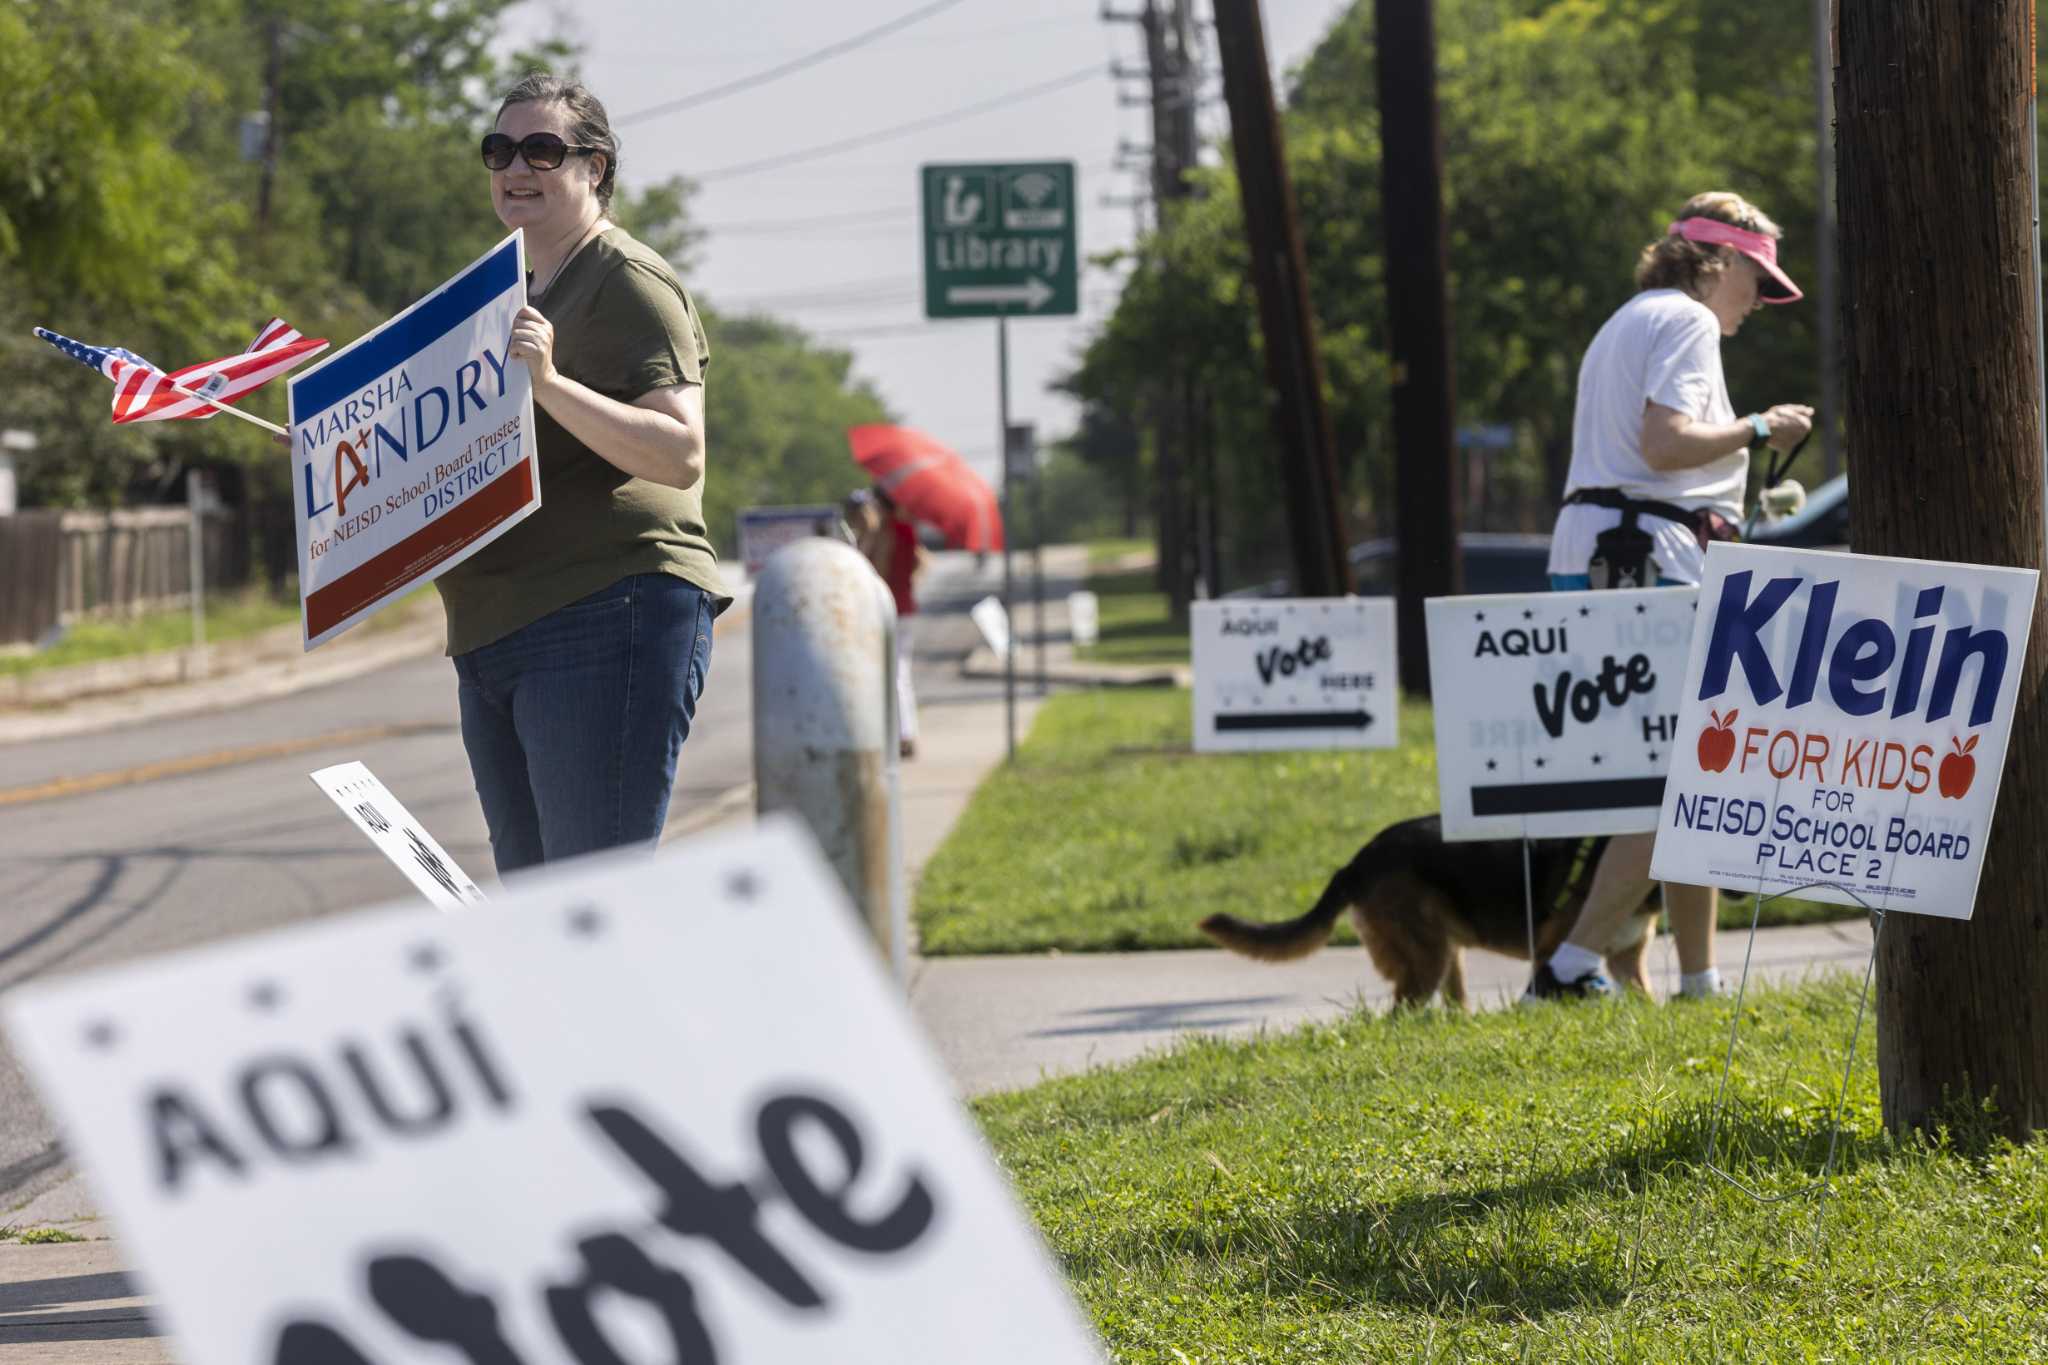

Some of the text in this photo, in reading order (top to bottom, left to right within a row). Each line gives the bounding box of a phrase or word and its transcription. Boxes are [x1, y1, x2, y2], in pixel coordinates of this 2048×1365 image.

[935, 232, 1063, 276] Library
[303, 368, 413, 455] MARSHA
[310, 415, 520, 559] for NEISD School Board Trustee
[423, 432, 522, 518] DISTRICT 7
[1256, 635, 1332, 687] Vote
[1475, 617, 1567, 657] AQUÍ
[1698, 570, 2009, 728] Klein
[1533, 654, 1656, 738] Vote
[1740, 728, 1829, 784] FOR
[1841, 738, 1934, 794] KIDS
[1674, 793, 1766, 836] NEISD
[1812, 789, 1854, 813] FOR
[1756, 843, 1882, 878] PLACE 2
